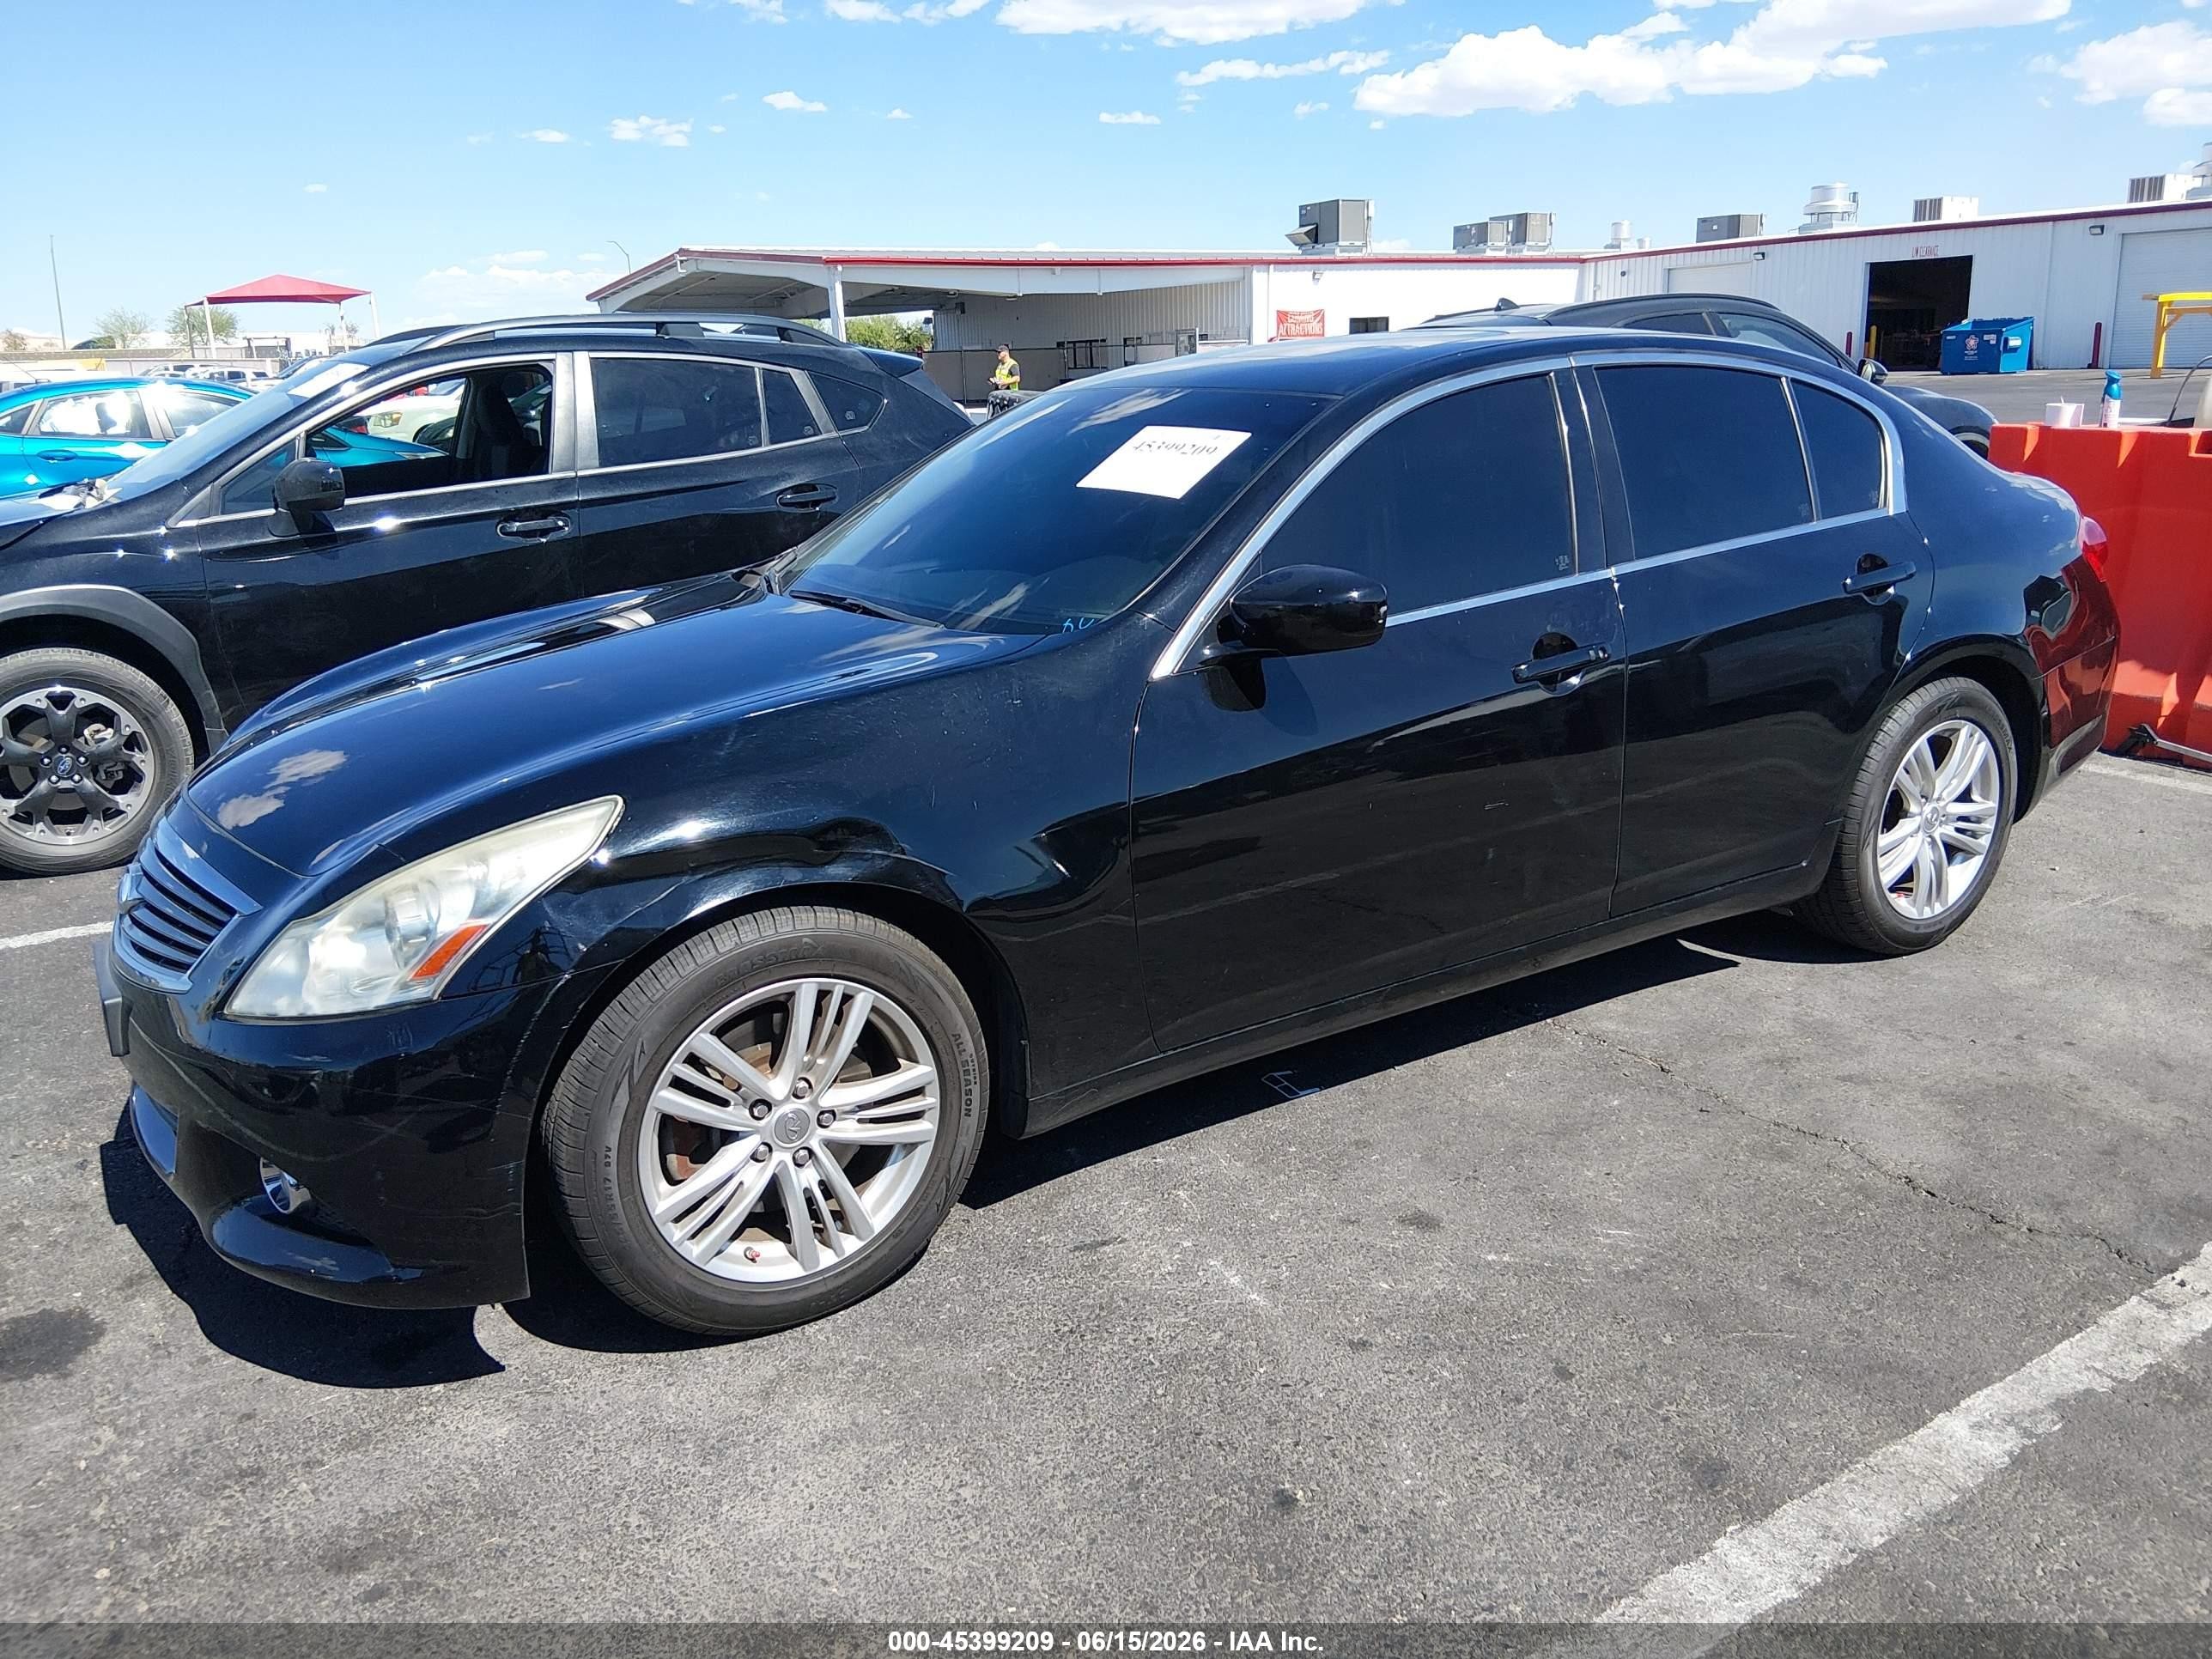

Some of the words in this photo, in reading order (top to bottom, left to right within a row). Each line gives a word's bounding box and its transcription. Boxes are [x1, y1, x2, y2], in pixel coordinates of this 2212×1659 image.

[1278, 322, 1323, 336] ATTRACTIONS
[951, 1033, 967, 1056] ALL
[961, 1059, 974, 1117] SEASON
